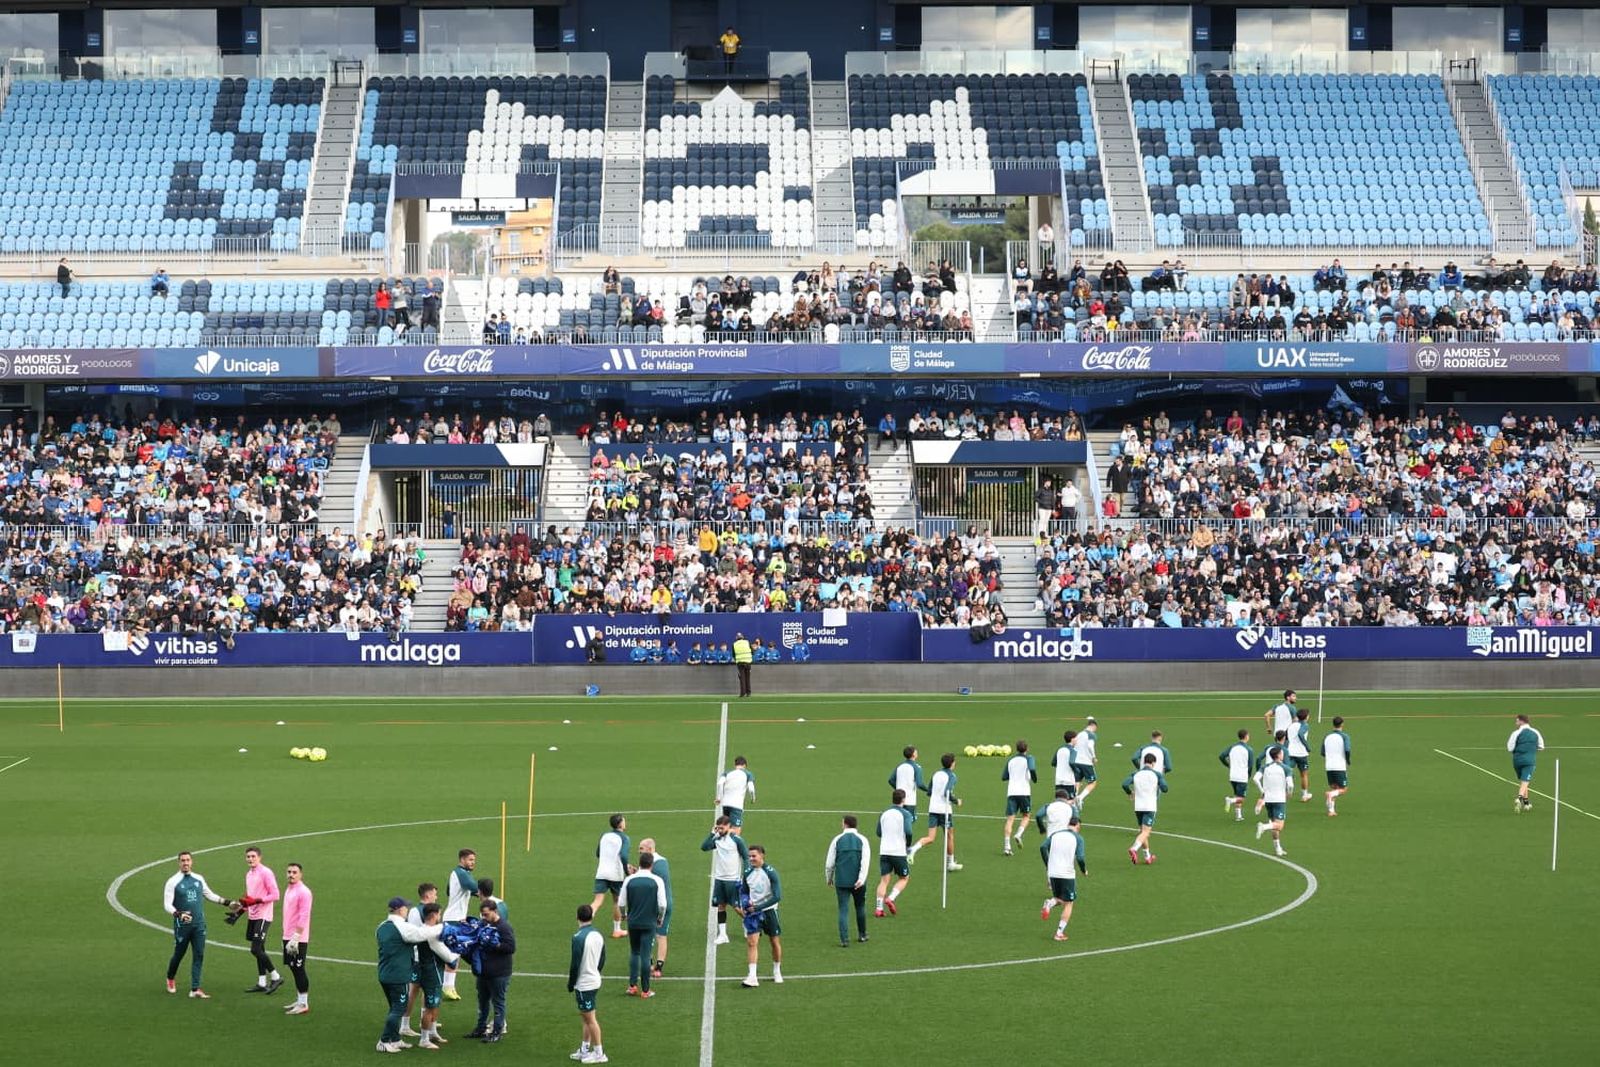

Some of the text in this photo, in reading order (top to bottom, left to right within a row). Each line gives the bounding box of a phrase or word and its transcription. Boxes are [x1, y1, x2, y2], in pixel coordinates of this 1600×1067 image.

[641, 348, 748, 359] Diputación Provincial
[914, 349, 943, 359] Ciudad
[1257, 347, 1307, 368] UAX
[1443, 347, 1500, 358] AMORES Y
[13, 354, 71, 364] AMORES Y
[914, 359, 955, 370] de Málaga
[1443, 357, 1508, 368] RODRÍGUEZ
[14, 362, 80, 375] RODRÍGUEZ
[223, 358, 280, 376] Unicaja
[641, 360, 694, 372] de Málaga
[605, 624, 713, 637] Diputación Provincial
[806, 627, 836, 636] Ciudad
[154, 637, 218, 655] vithas
[605, 638, 619, 648] de
[806, 636, 848, 647] de Málaga
[1264, 651, 1278, 659] vivir
[1280, 652, 1296, 660] para
[171, 658, 187, 667] para
[188, 657, 218, 665] cuidarte
